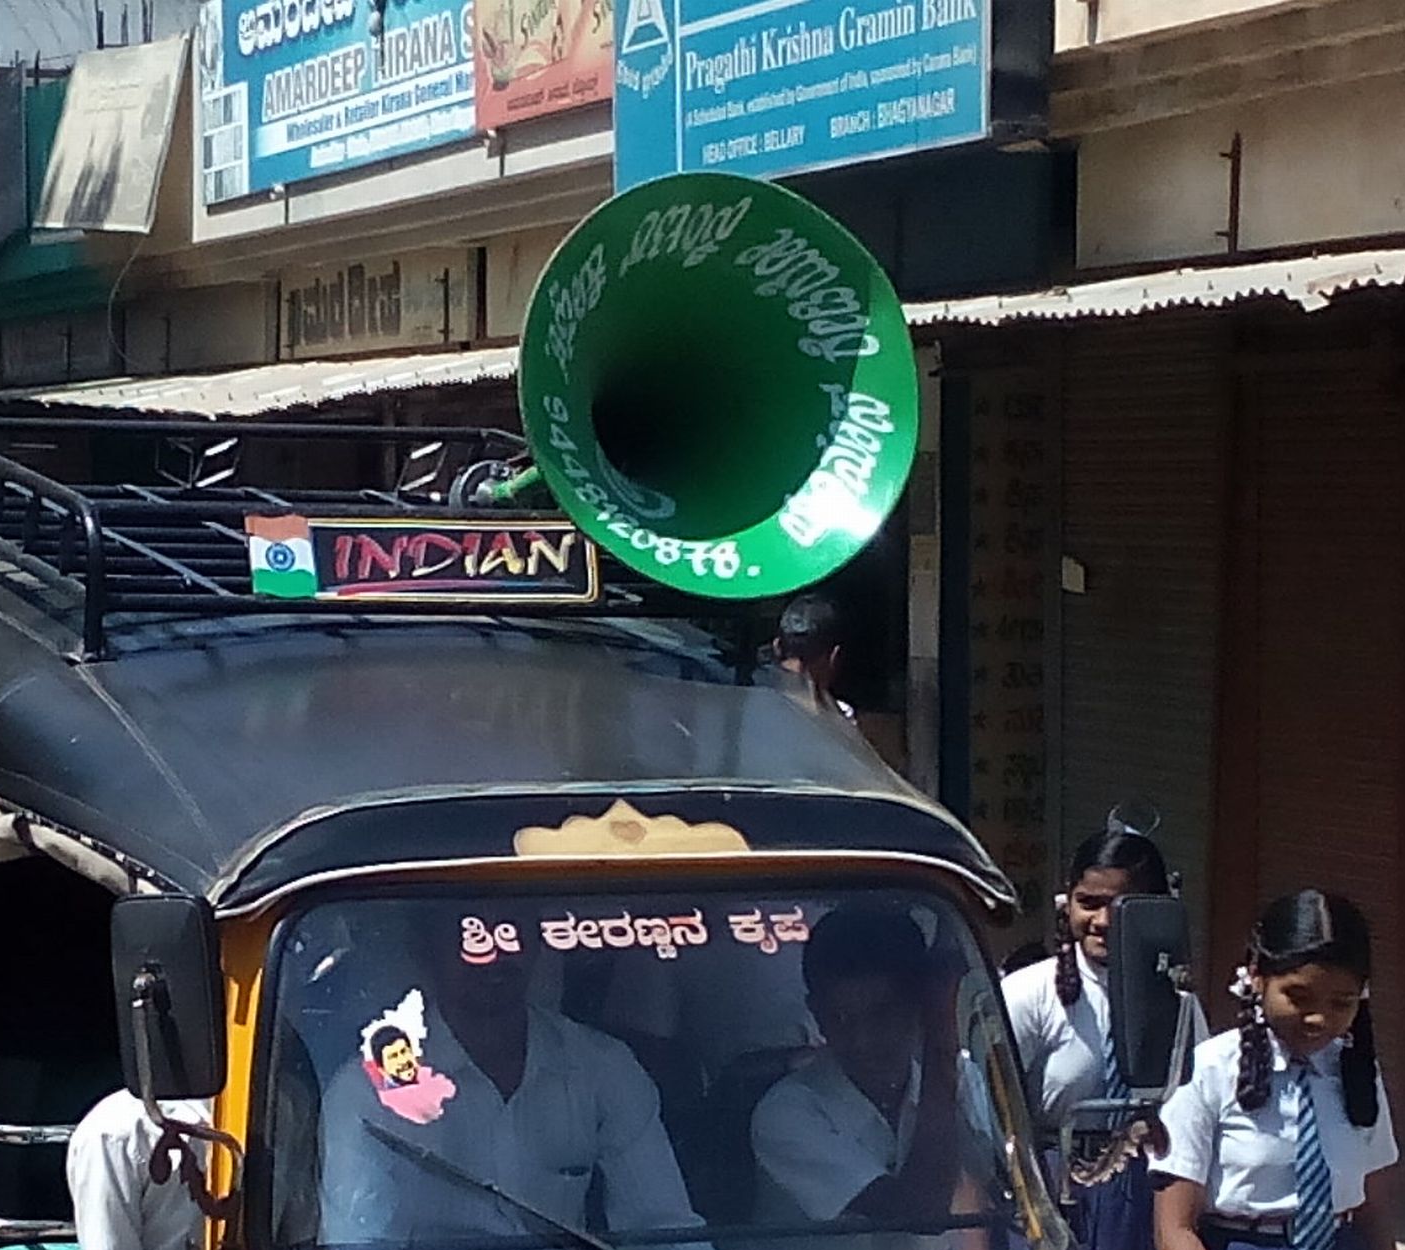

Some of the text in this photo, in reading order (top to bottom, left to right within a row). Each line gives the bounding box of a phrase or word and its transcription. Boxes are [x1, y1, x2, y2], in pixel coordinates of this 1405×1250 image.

[685, 34, 757, 93] Pragathi
[761, 21, 834, 71] Krishna
[838, 1, 916, 51] Gramin
[921, 0, 977, 31] Bank
[263, 44, 366, 119] AMARDEEP
[764, 125, 806, 156] BELLARY
[830, 110, 870, 138] BRANCH
[335, 531, 576, 579] INDIAN
[461, 916, 521, 964] ಶ್ರೀ
